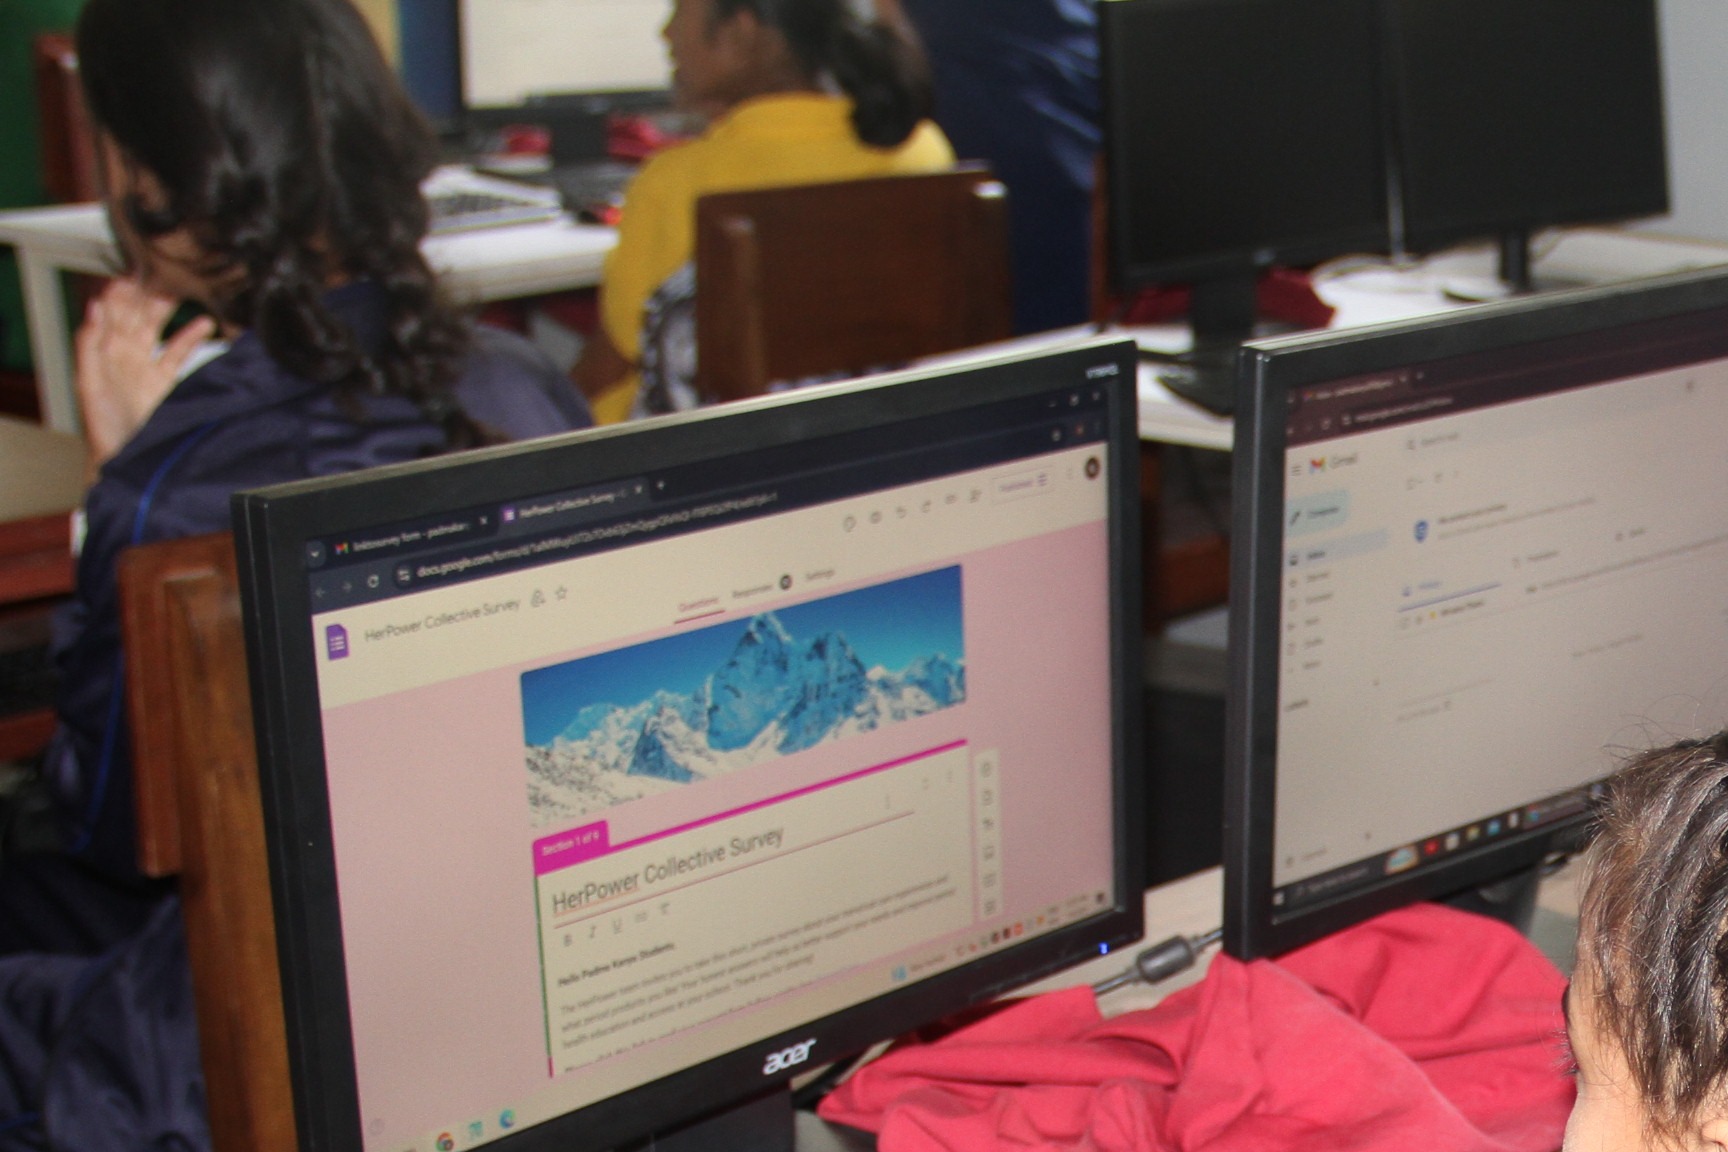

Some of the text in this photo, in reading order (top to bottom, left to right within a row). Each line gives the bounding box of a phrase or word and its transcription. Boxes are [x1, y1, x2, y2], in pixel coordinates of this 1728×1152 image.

[364, 600, 521, 642] HerPower Collective Survey
[552, 827, 785, 914] HerPower Collective Survey
[762, 1037, 818, 1076] acer
